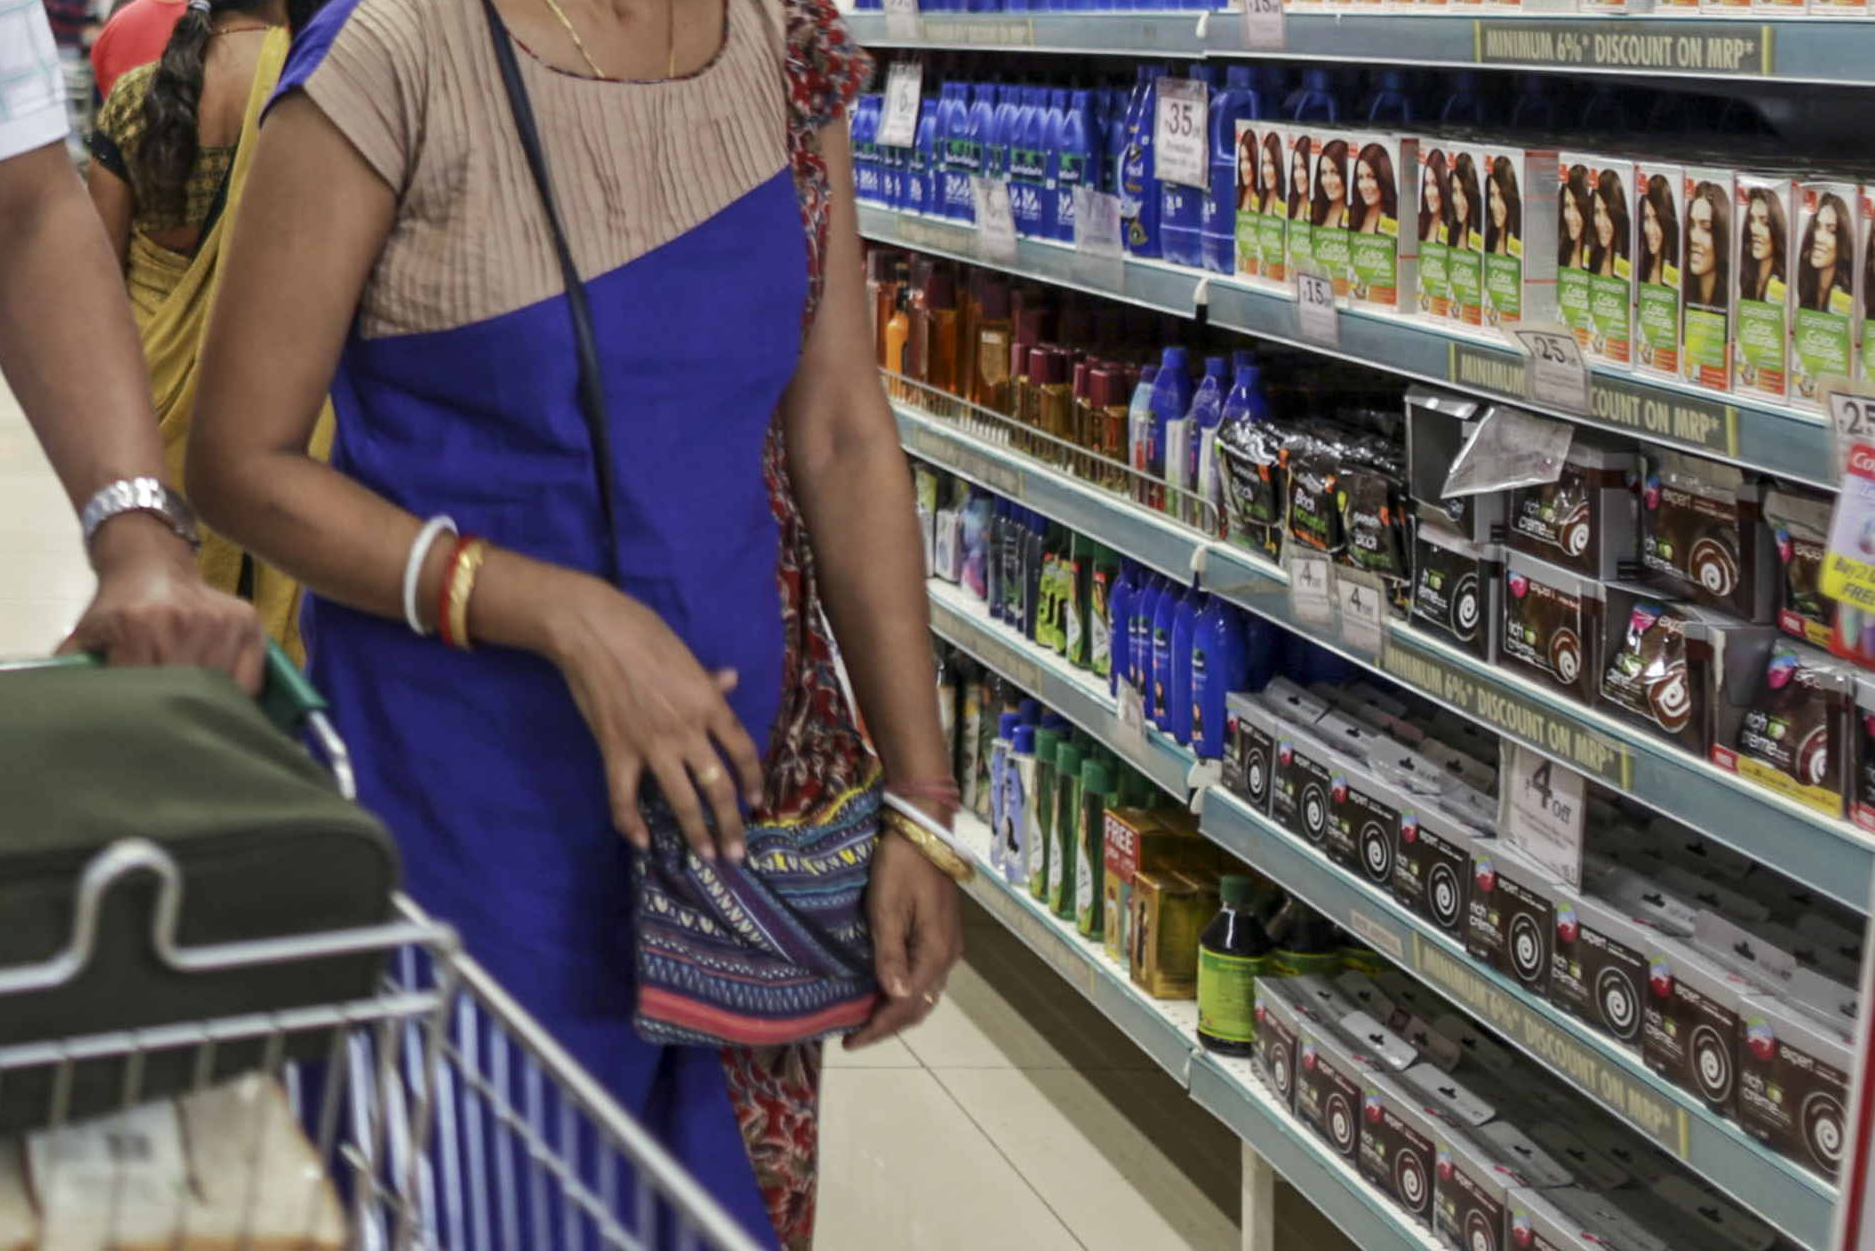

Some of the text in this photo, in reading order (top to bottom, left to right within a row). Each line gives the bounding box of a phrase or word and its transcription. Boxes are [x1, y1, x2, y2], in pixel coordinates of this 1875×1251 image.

[1487, 30, 1554, 62] MINIMUM
[1594, 34, 1673, 68] DISCOUNT
[1677, 37, 1703, 68] ON
[1566, 283, 1587, 298] Color
[1596, 292, 1620, 308] Color
[1645, 301, 1669, 317] Color
[1745, 319, 1774, 335] Color
[1806, 329, 1838, 347] Color
[1644, 397, 1670, 433] ON
[1662, 487, 1692, 509] expert
[1834, 555, 1855, 575] Buy
[1385, 652, 1443, 698] MINIMUM
[1477, 690, 1545, 739] DISCOUNT
[1548, 722, 1571, 748] ON
[1551, 796, 1574, 825] off
[1104, 815, 1135, 856] FREE
[1498, 876, 1520, 895] expert
[1469, 901, 1488, 919] rich
[1469, 915, 1497, 937] creme
[1580, 927, 1608, 950] expert
[1552, 953, 1569, 972] rich
[1674, 982, 1702, 1006] expert
[1645, 1008, 1663, 1030] rich
[1525, 1019, 1599, 1082] DISCOUNT
[1601, 1067, 1626, 1100] ON
[1779, 1045, 1814, 1074] expert
[1742, 1070, 1765, 1092] rich
[1742, 1086, 1778, 1116] creme
